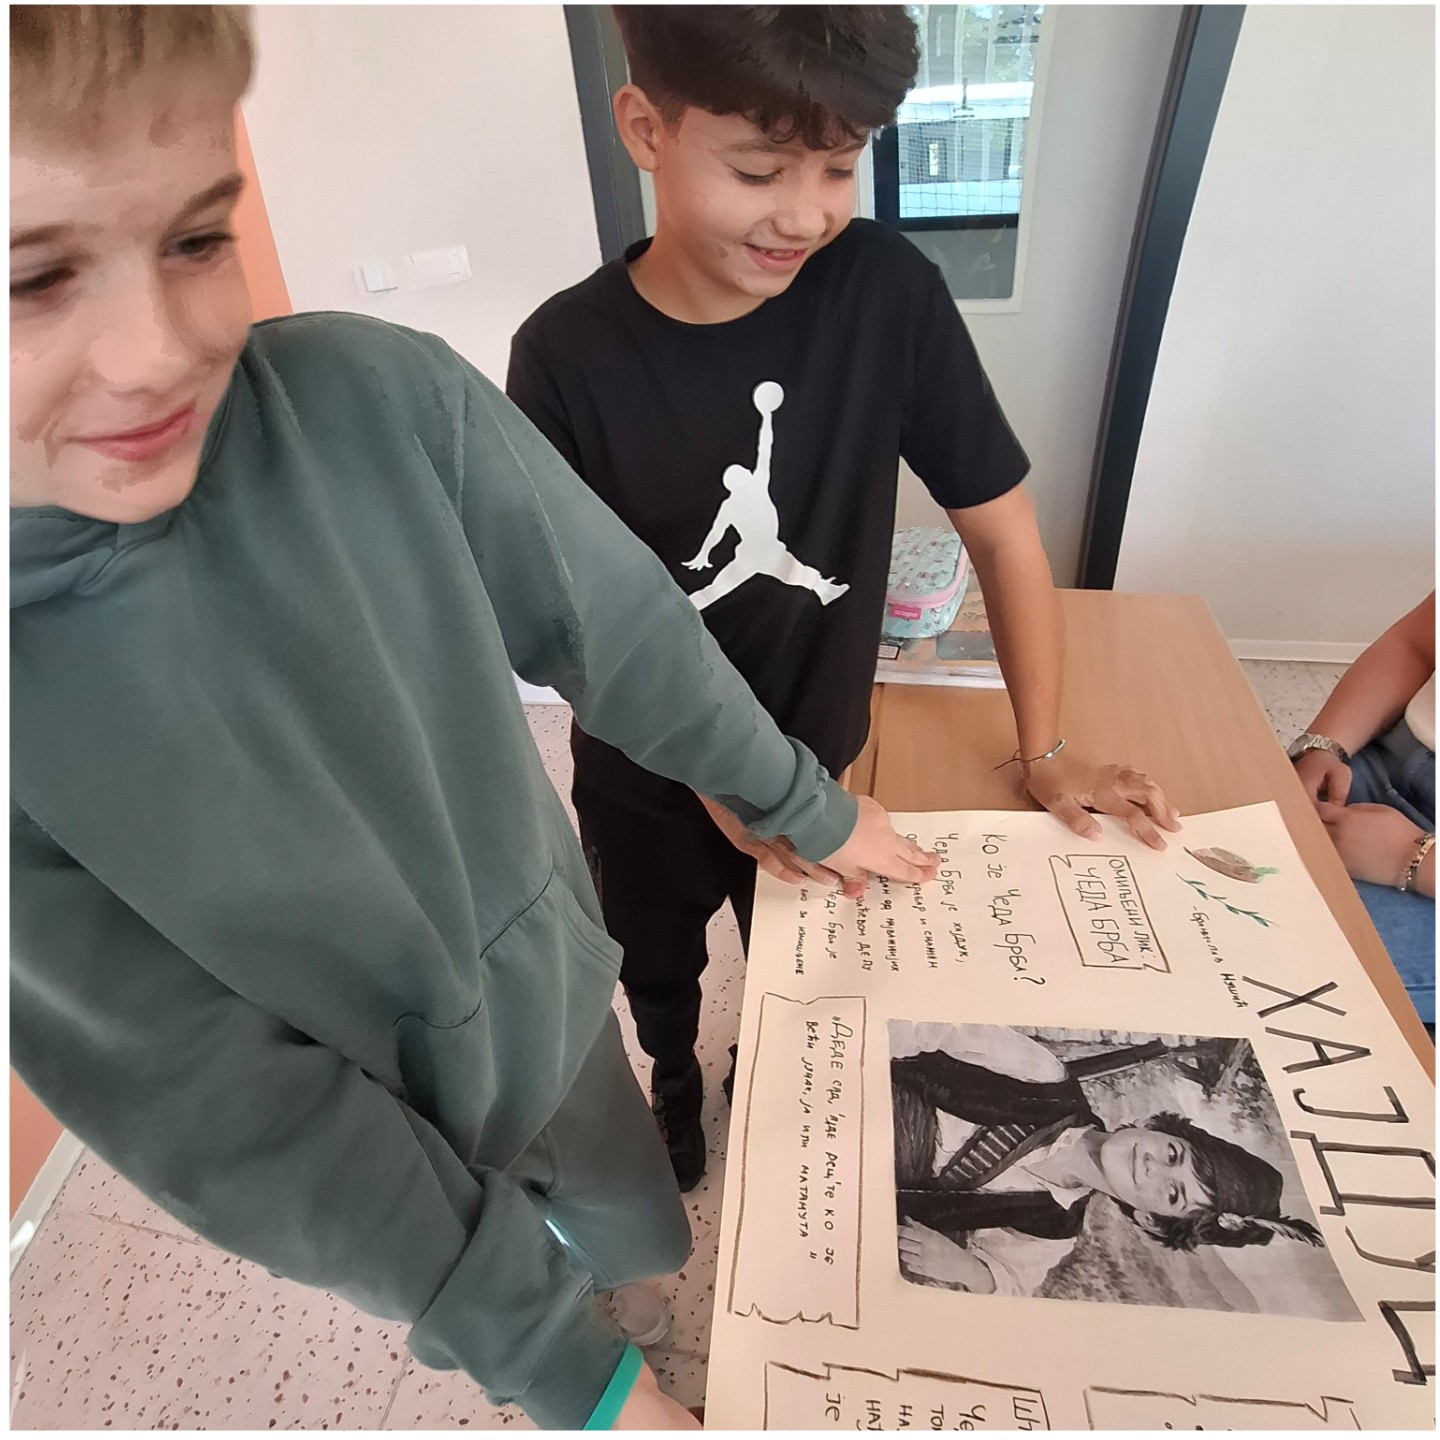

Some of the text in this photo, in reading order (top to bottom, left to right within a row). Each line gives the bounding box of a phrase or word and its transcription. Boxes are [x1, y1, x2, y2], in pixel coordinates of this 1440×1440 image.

[940, 899, 958, 912] је
[1074, 868, 1129, 962] ЧЕДА БРБА
[1109, 859, 1143, 926] ОМИЉЕНИ
